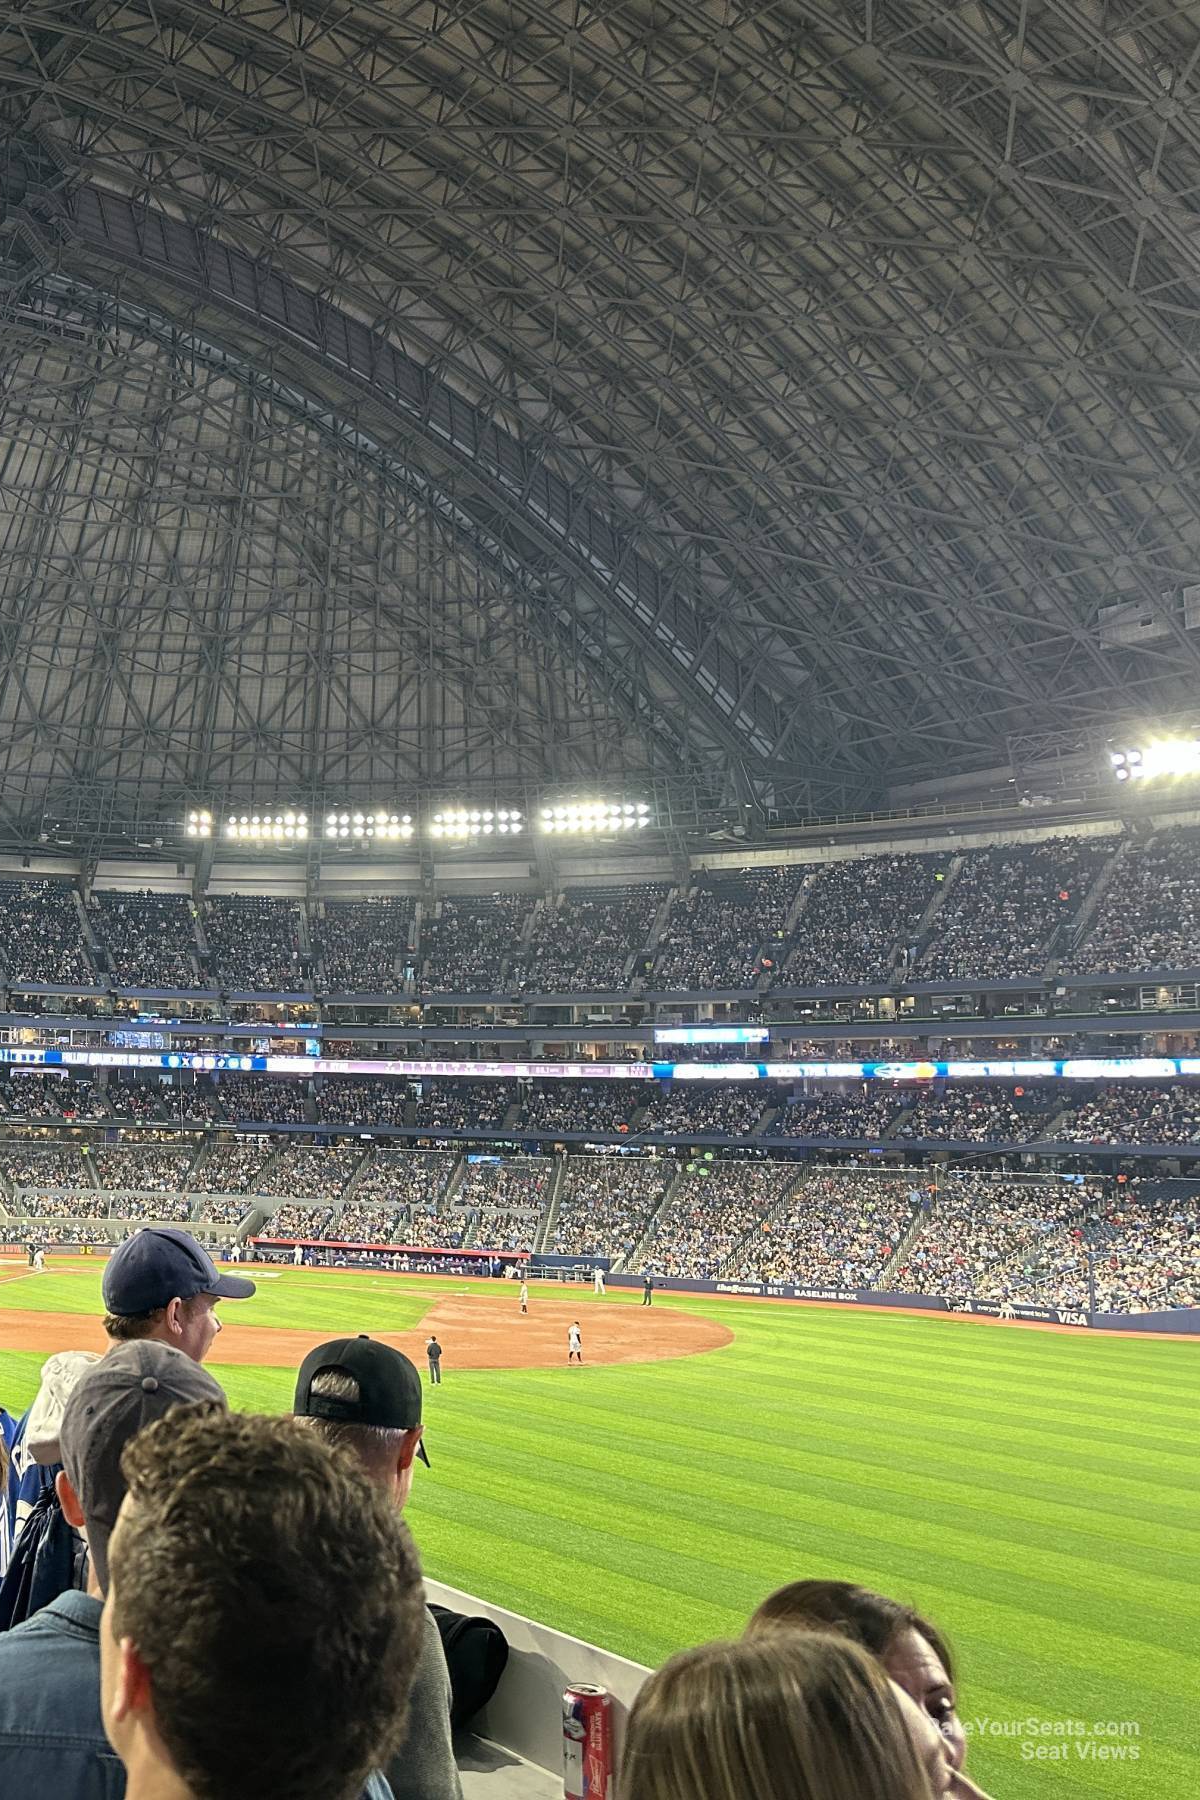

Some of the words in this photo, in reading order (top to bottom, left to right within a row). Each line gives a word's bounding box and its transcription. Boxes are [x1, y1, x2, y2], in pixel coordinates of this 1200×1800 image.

[767, 1286, 785, 1295] BET
[794, 1289, 837, 1299] BASELINE
[838, 1292, 858, 1300] BOX
[944, 1298, 972, 1312] VSA
[1055, 1310, 1088, 1326] VISA
